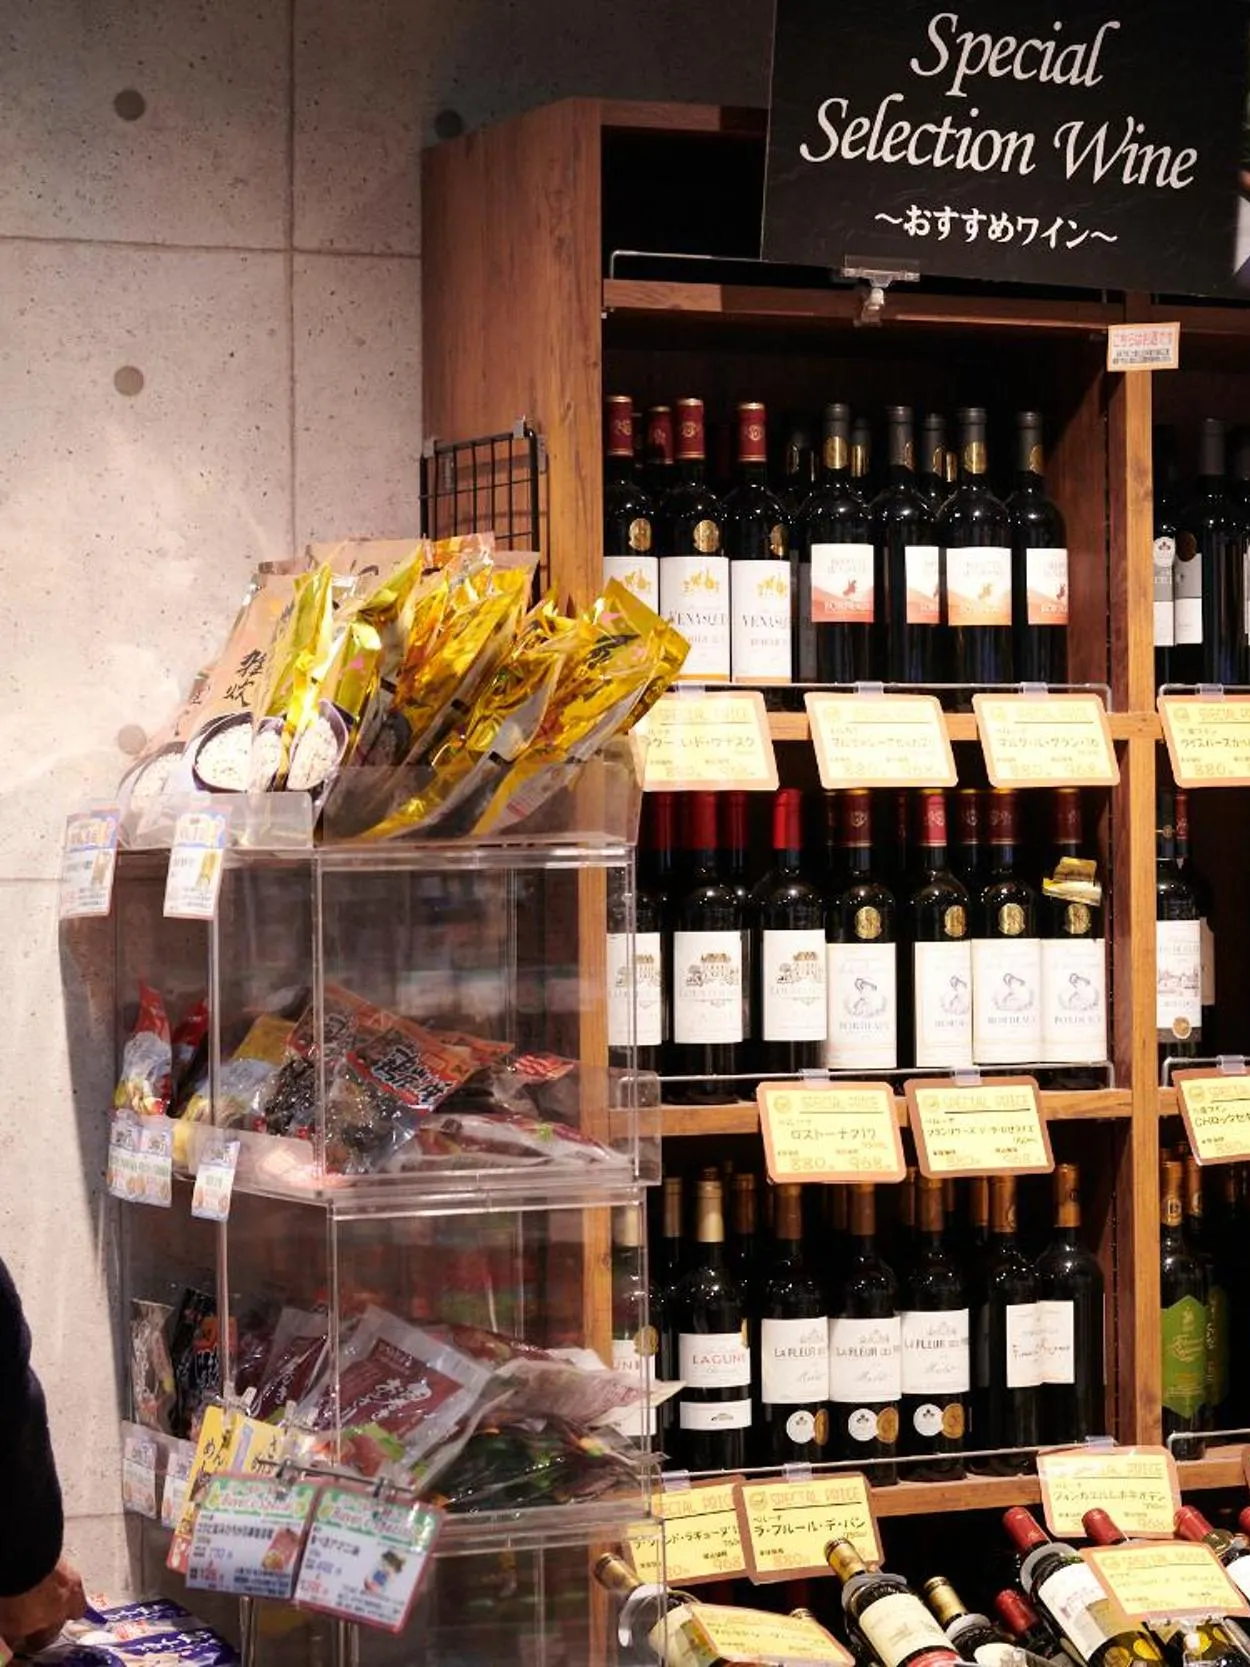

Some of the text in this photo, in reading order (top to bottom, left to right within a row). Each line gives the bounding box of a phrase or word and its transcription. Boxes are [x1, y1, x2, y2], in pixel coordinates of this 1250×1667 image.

[911, 13, 1120, 97] Special
[800, 94, 1197, 188] Selection Wine
[702, 1494, 734, 1509] PRIC
